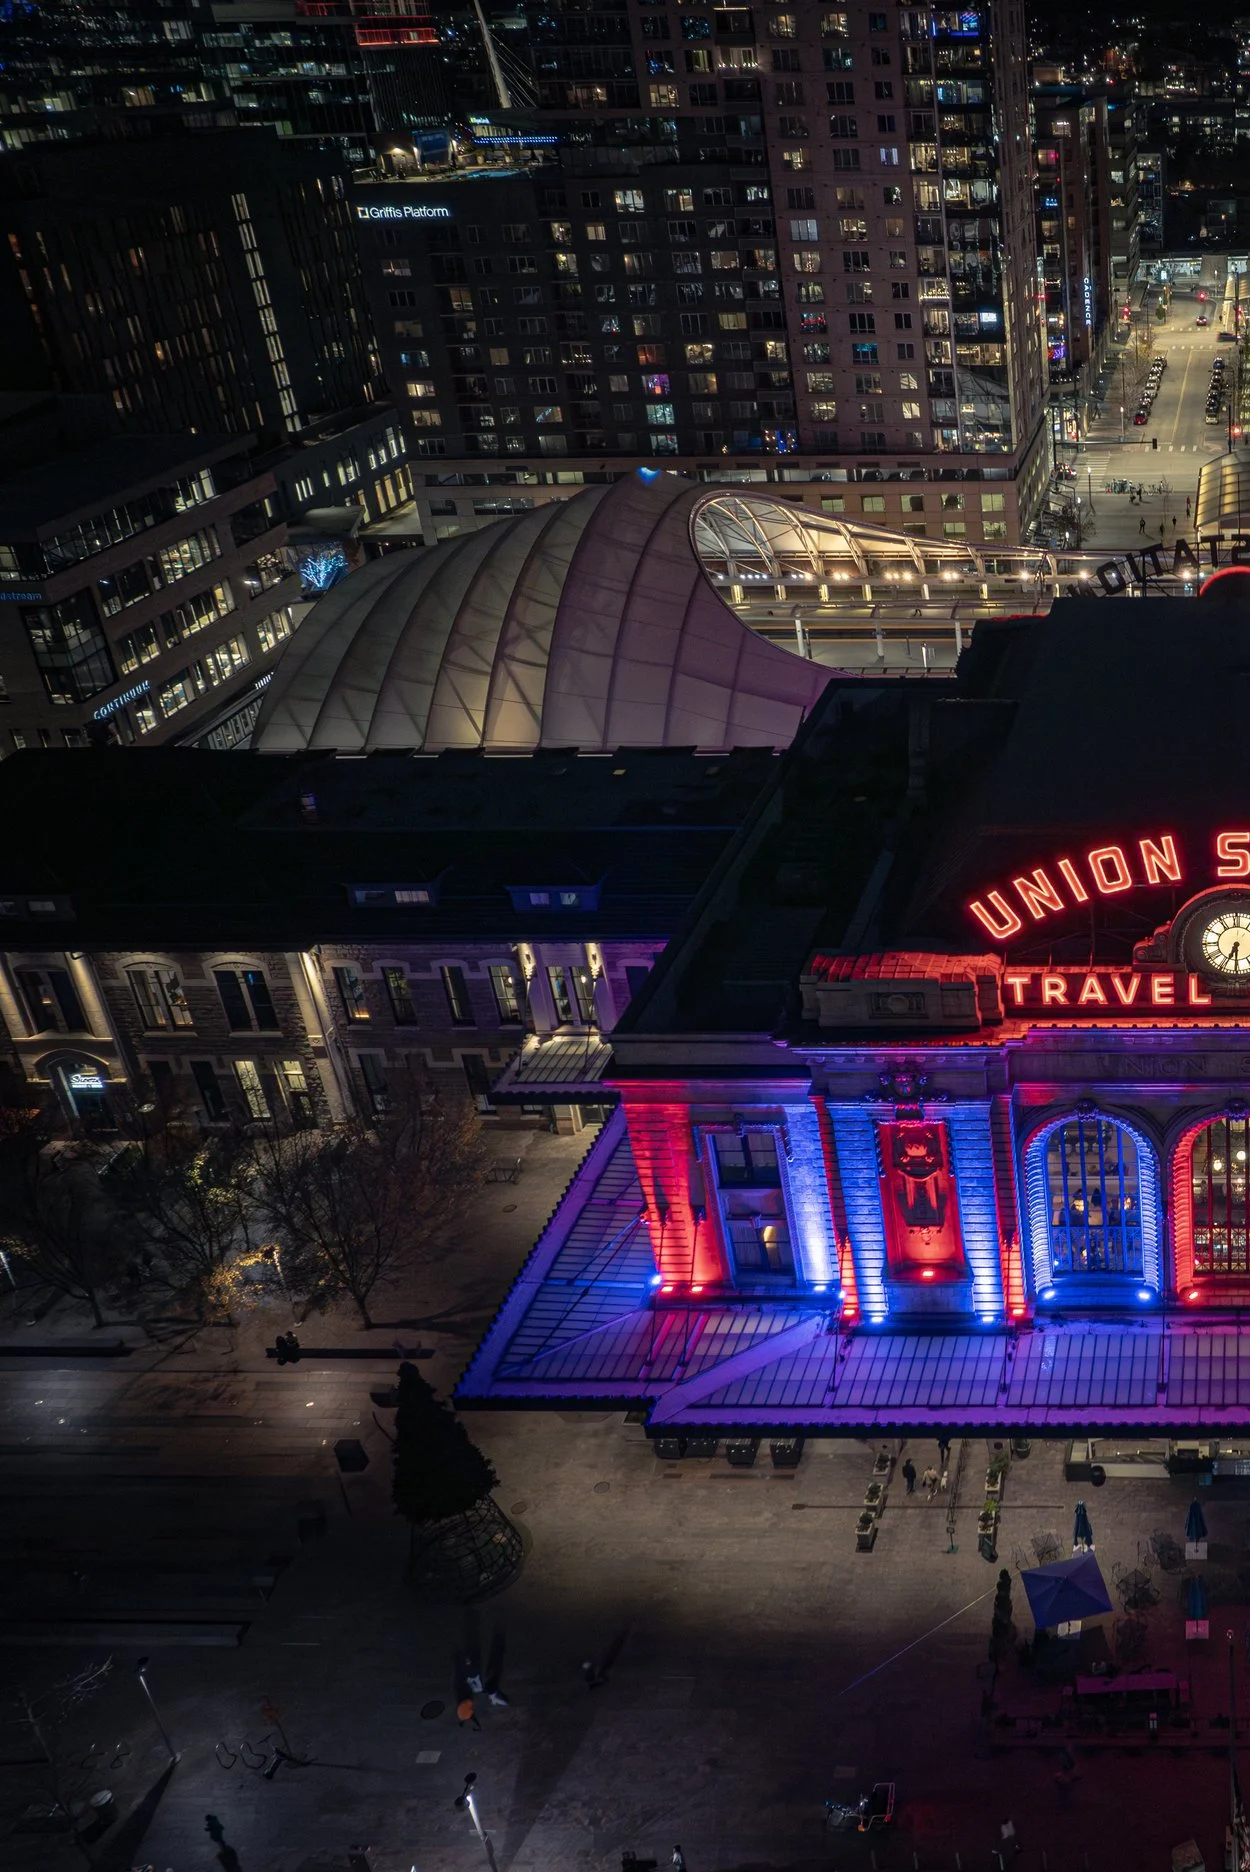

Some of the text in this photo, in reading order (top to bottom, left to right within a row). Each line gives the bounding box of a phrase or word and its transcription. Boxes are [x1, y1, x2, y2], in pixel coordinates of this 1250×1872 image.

[369, 203, 450, 220] Griffis Platform
[93, 679, 151, 720] CONTINUUM
[970, 835, 1182, 940] UNION
[1006, 973, 1212, 1005] TRAVEL
[1097, 1055, 1208, 1075] UNION
